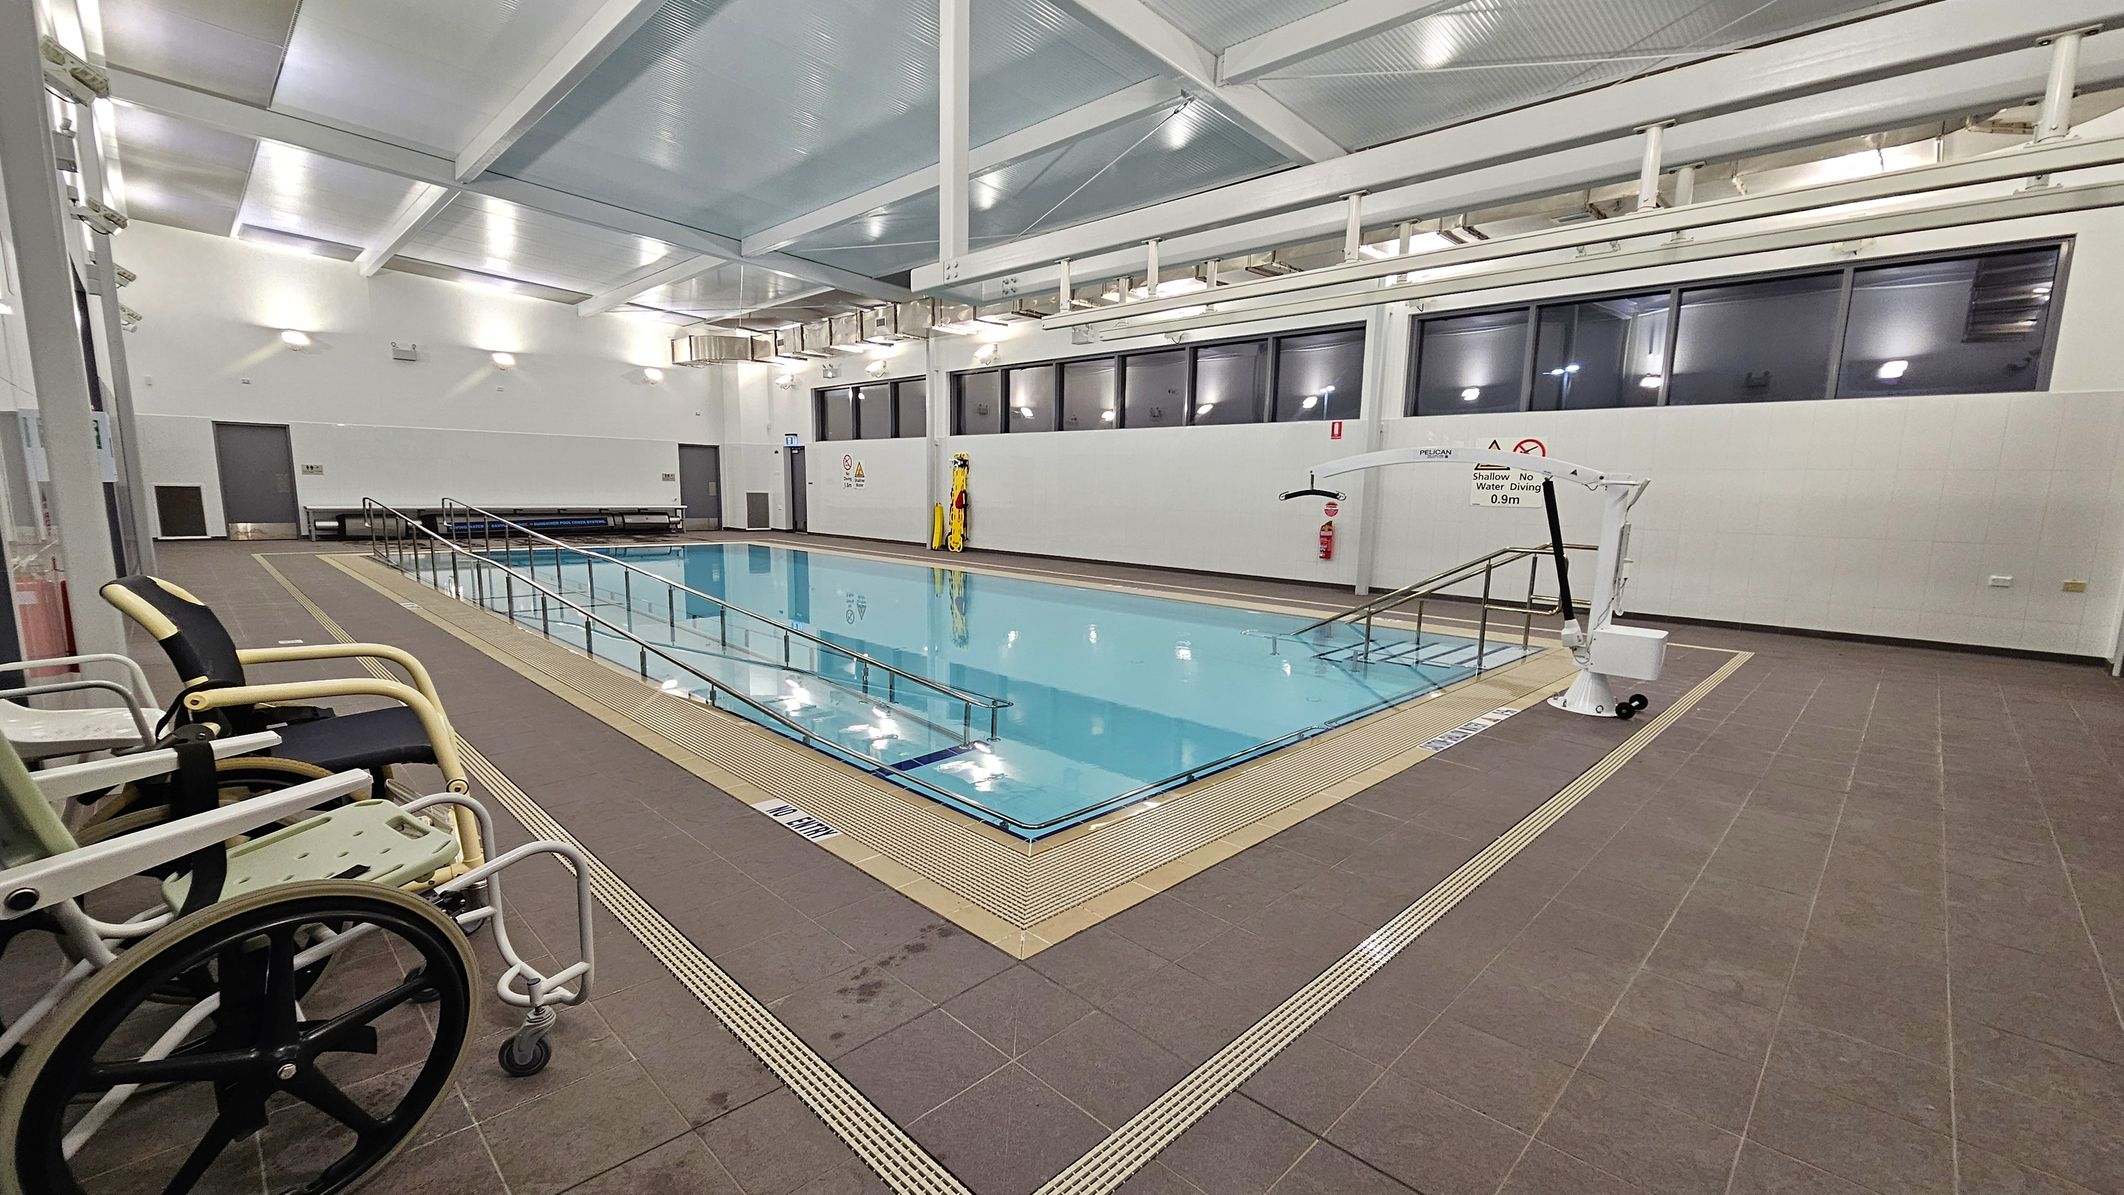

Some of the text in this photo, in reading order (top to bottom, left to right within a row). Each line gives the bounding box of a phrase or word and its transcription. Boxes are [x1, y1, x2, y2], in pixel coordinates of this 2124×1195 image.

[1473, 472, 1534, 481] Shallow No
[1476, 482, 1541, 493] Water Diving
[1490, 494, 1520, 504] 0.9m
[766, 804, 839, 839] NO ENTRY
